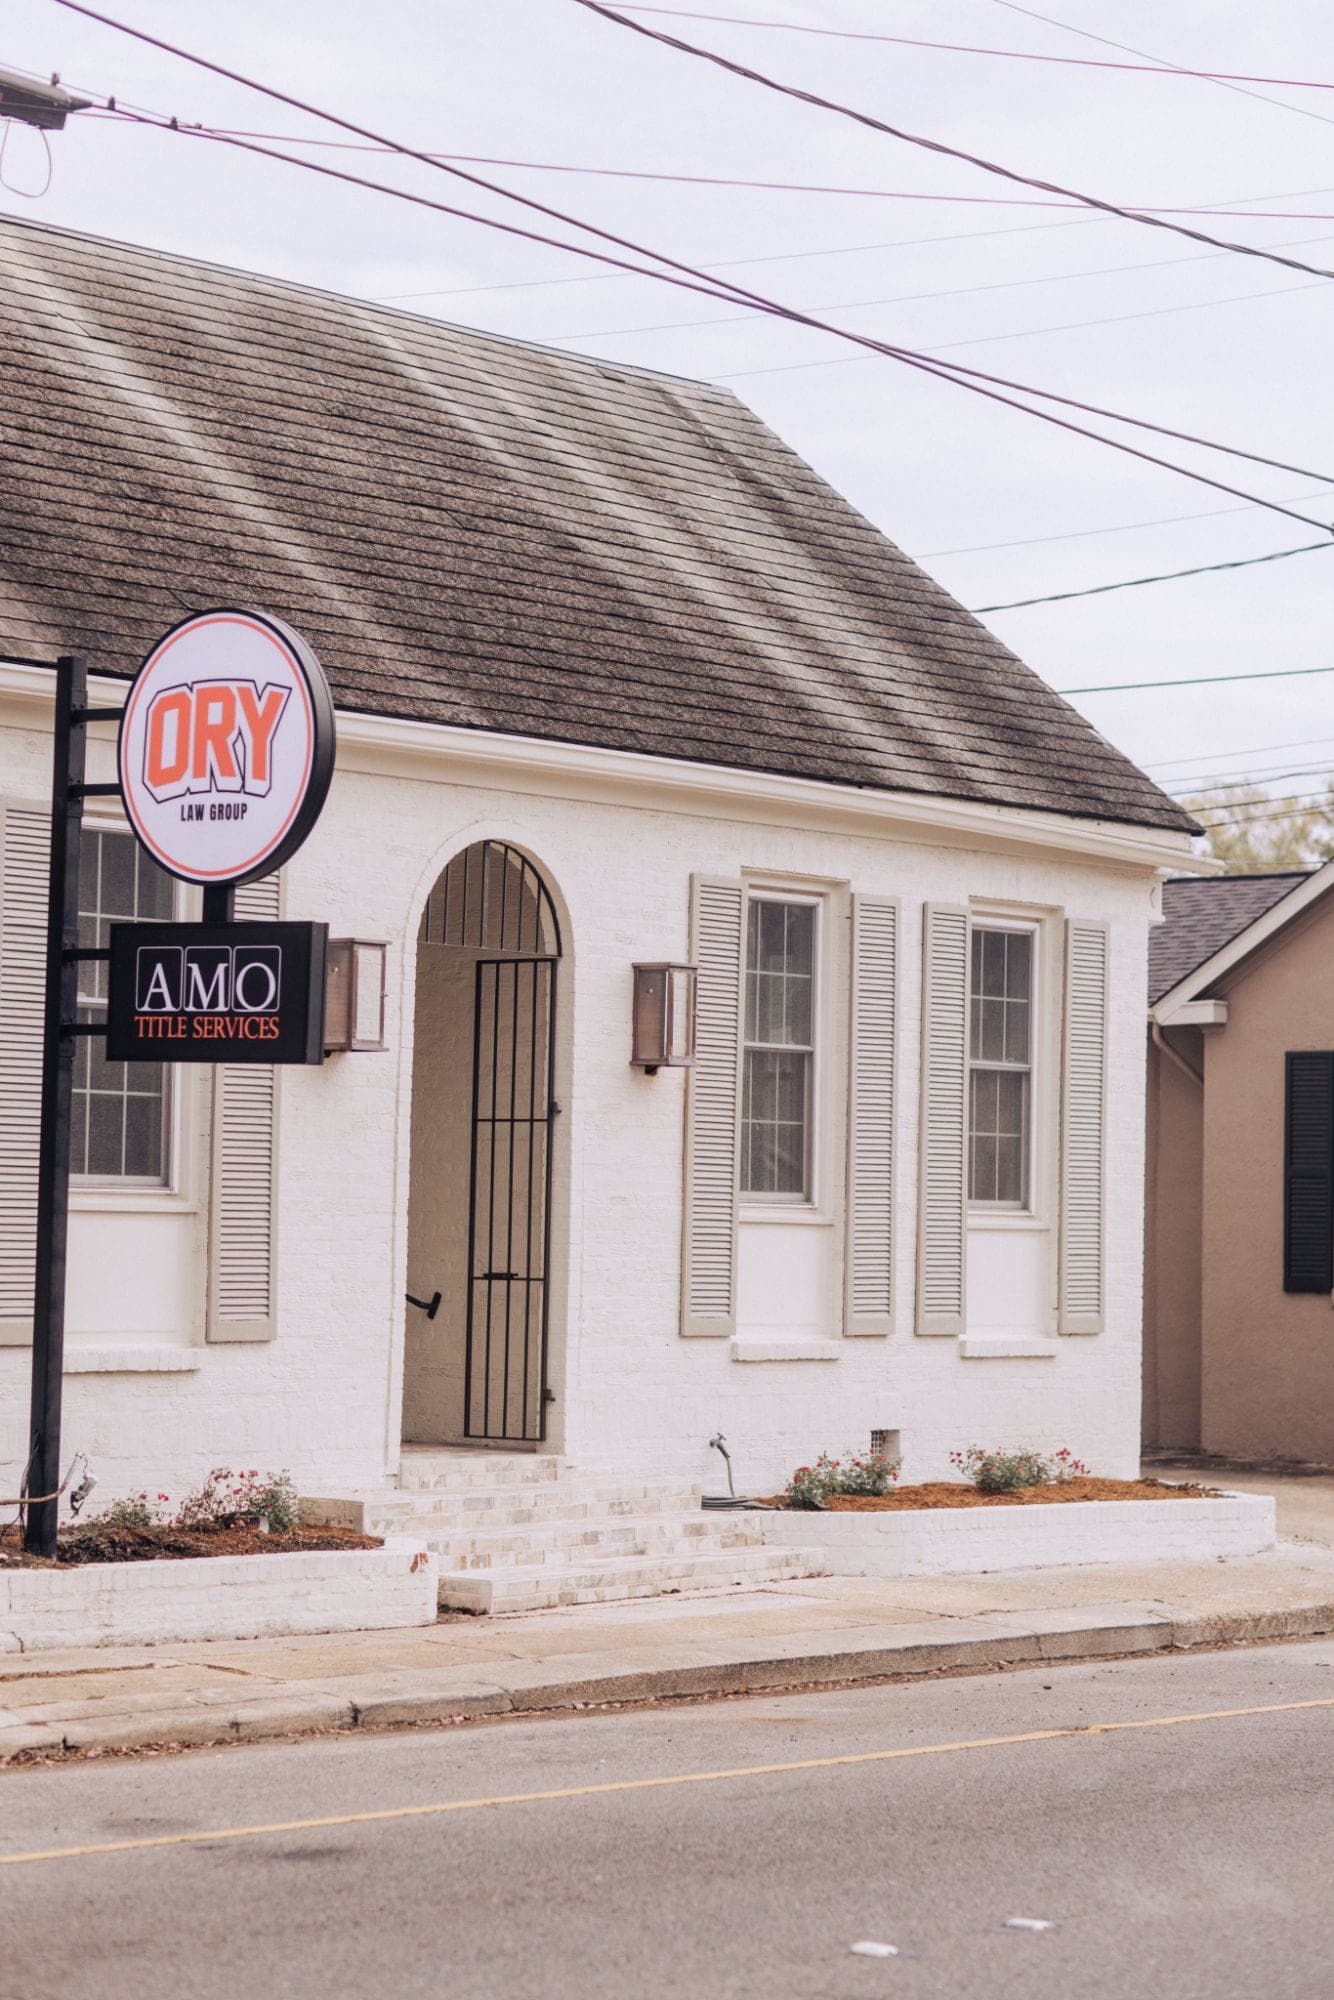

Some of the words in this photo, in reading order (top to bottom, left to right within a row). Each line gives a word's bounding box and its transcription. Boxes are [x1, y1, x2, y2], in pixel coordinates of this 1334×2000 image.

[146, 684, 287, 793] ORY
[180, 803, 204, 822] LAW
[210, 802, 248, 821] GROUP
[137, 962, 276, 1013] AMO
[134, 1015, 188, 1039] TITLE
[192, 1015, 280, 1040] SERVICES
